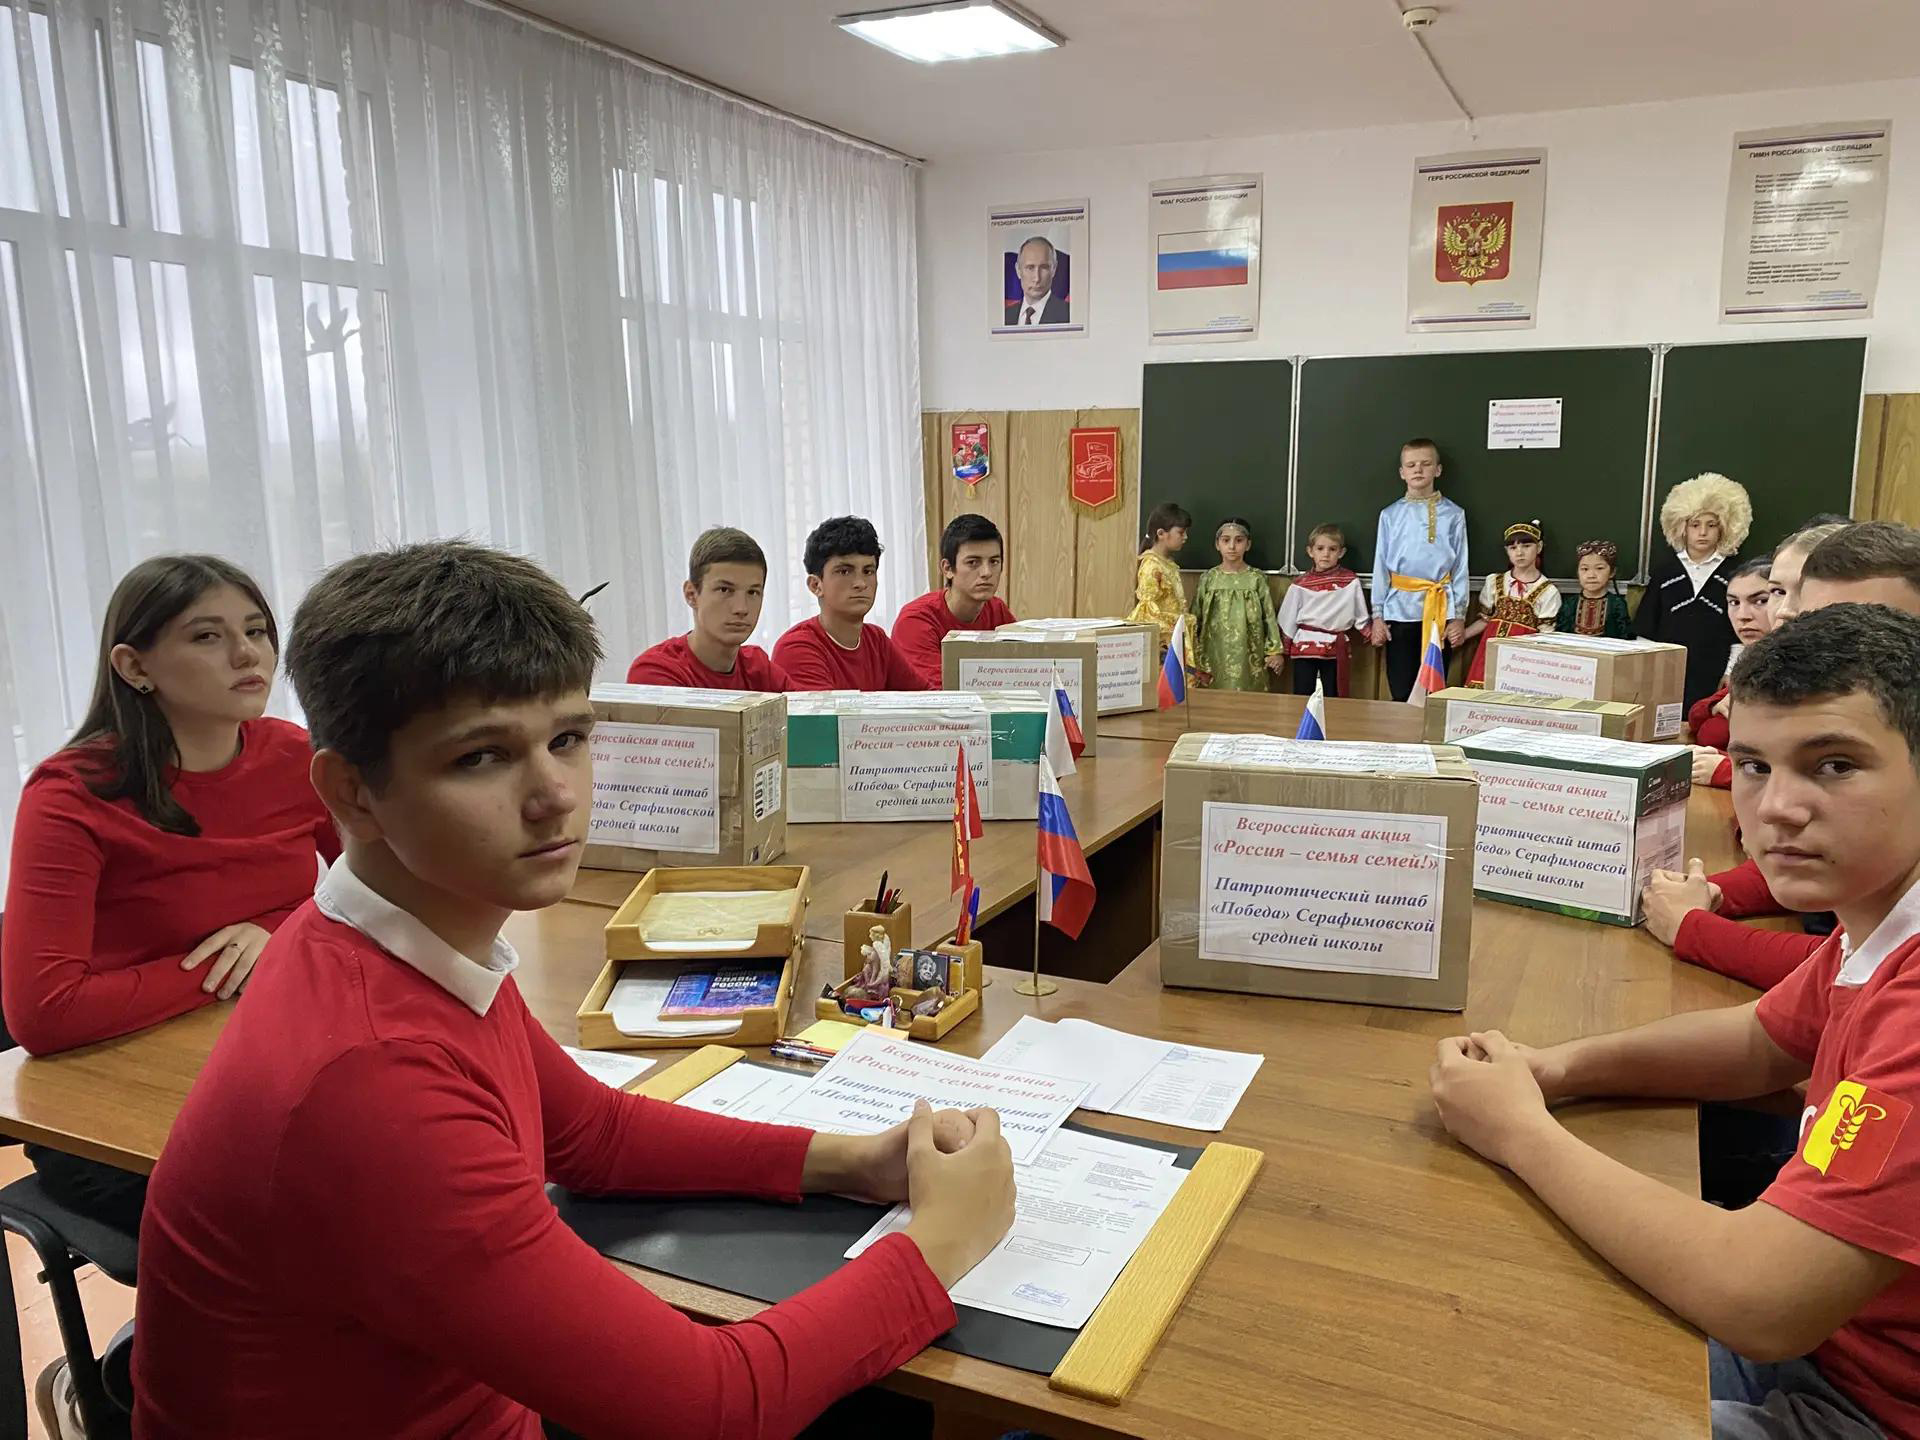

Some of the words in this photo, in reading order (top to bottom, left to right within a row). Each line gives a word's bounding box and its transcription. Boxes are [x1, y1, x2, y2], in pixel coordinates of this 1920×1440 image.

[977, 665, 1038, 675] Всероссийская
[965, 679, 1003, 687] «Россия
[1468, 710, 1543, 727] Всероссийская
[1546, 721, 1579, 731] акция
[861, 723, 936, 735] Всероссийская
[939, 723, 969, 731] акция
[590, 733, 658, 746] ероссийская
[661, 739, 695, 749] акция
[847, 740, 893, 750] «Россия
[906, 740, 940, 748] семья
[624, 755, 661, 765] семья
[664, 757, 714, 769] семей!»
[850, 763, 948, 777] Патриотический
[672, 787, 709, 798] штаб
[847, 780, 899, 792] «Победа»
[1566, 786, 1608, 799] акция
[620, 800, 715, 817] Серафимовской
[876, 796, 918, 808] средней
[1522, 802, 1565, 815] семья
[1569, 807, 1630, 823] семей!»
[590, 818, 636, 830] средней
[639, 823, 680, 834] школы
[1236, 817, 1356, 838] Всероссийская
[1360, 829, 1411, 844] акция
[1213, 839, 1285, 858] «Россия
[1306, 849, 1359, 865] семья
[1365, 853, 1439, 870] семей!»
[1577, 842, 1621, 854] штаб
[1515, 848, 1627, 876] Серафимовской
[1481, 862, 1533, 880] средней
[1536, 873, 1584, 889] школы
[1214, 876, 1369, 903] Патриотический
[1374, 894, 1429, 908] штаб
[1210, 901, 1290, 920] «Победа»
[1296, 908, 1435, 933] Серафимовской
[1251, 929, 1319, 947] средней
[1323, 938, 1384, 953] школы
[881, 1045, 1000, 1078] Всероссийская
[1004, 1074, 1056, 1088] акция
[848, 1055, 920, 1078] «Россия
[938, 1077, 995, 1090] семья
[997, 1086, 1075, 1104] семей!»
[811, 1089, 893, 1109] «Победа»
[840, 1109, 900, 1125] средне
